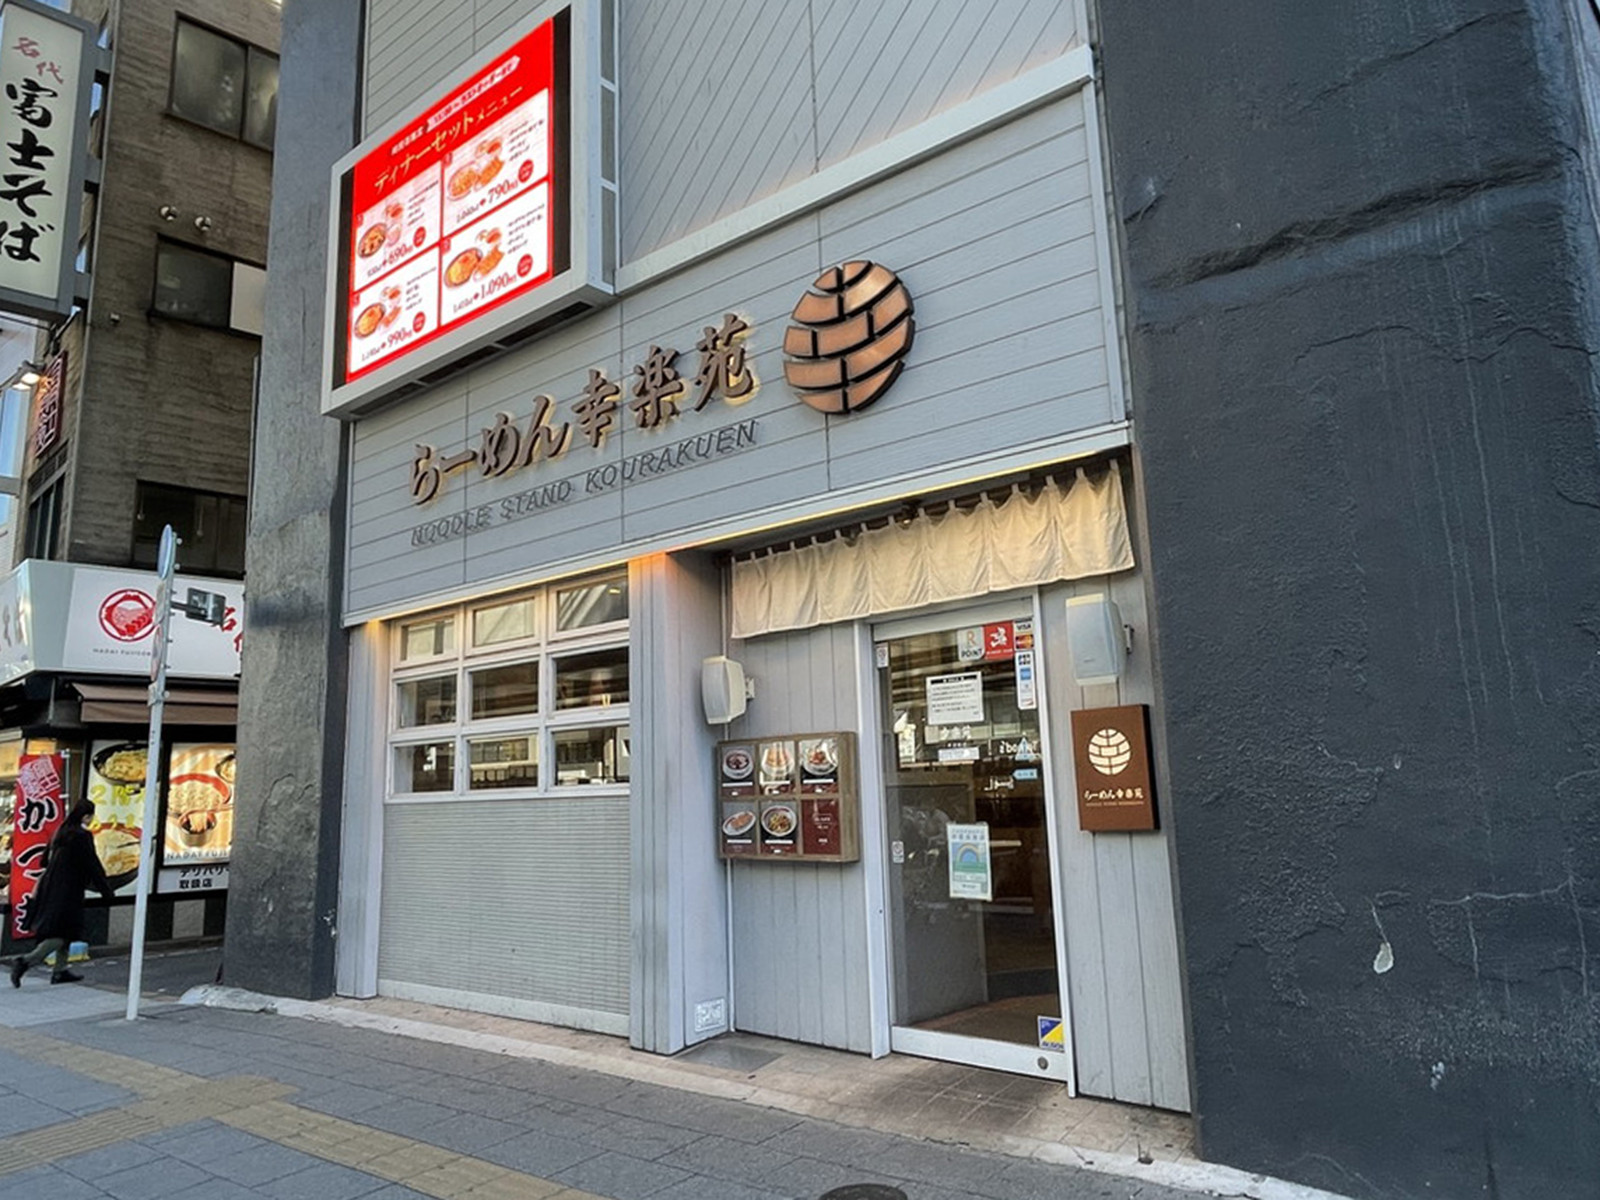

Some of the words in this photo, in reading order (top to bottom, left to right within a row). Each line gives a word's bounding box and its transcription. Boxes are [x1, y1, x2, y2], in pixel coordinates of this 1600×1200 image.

[0, 77, 58, 263] 富士そば
[408, 312, 756, 506] らーめん幸楽苑
[410, 507, 492, 547] NOODLE
[500, 480, 573, 519] STAND
[585, 419, 760, 493] KOURAKUEN
